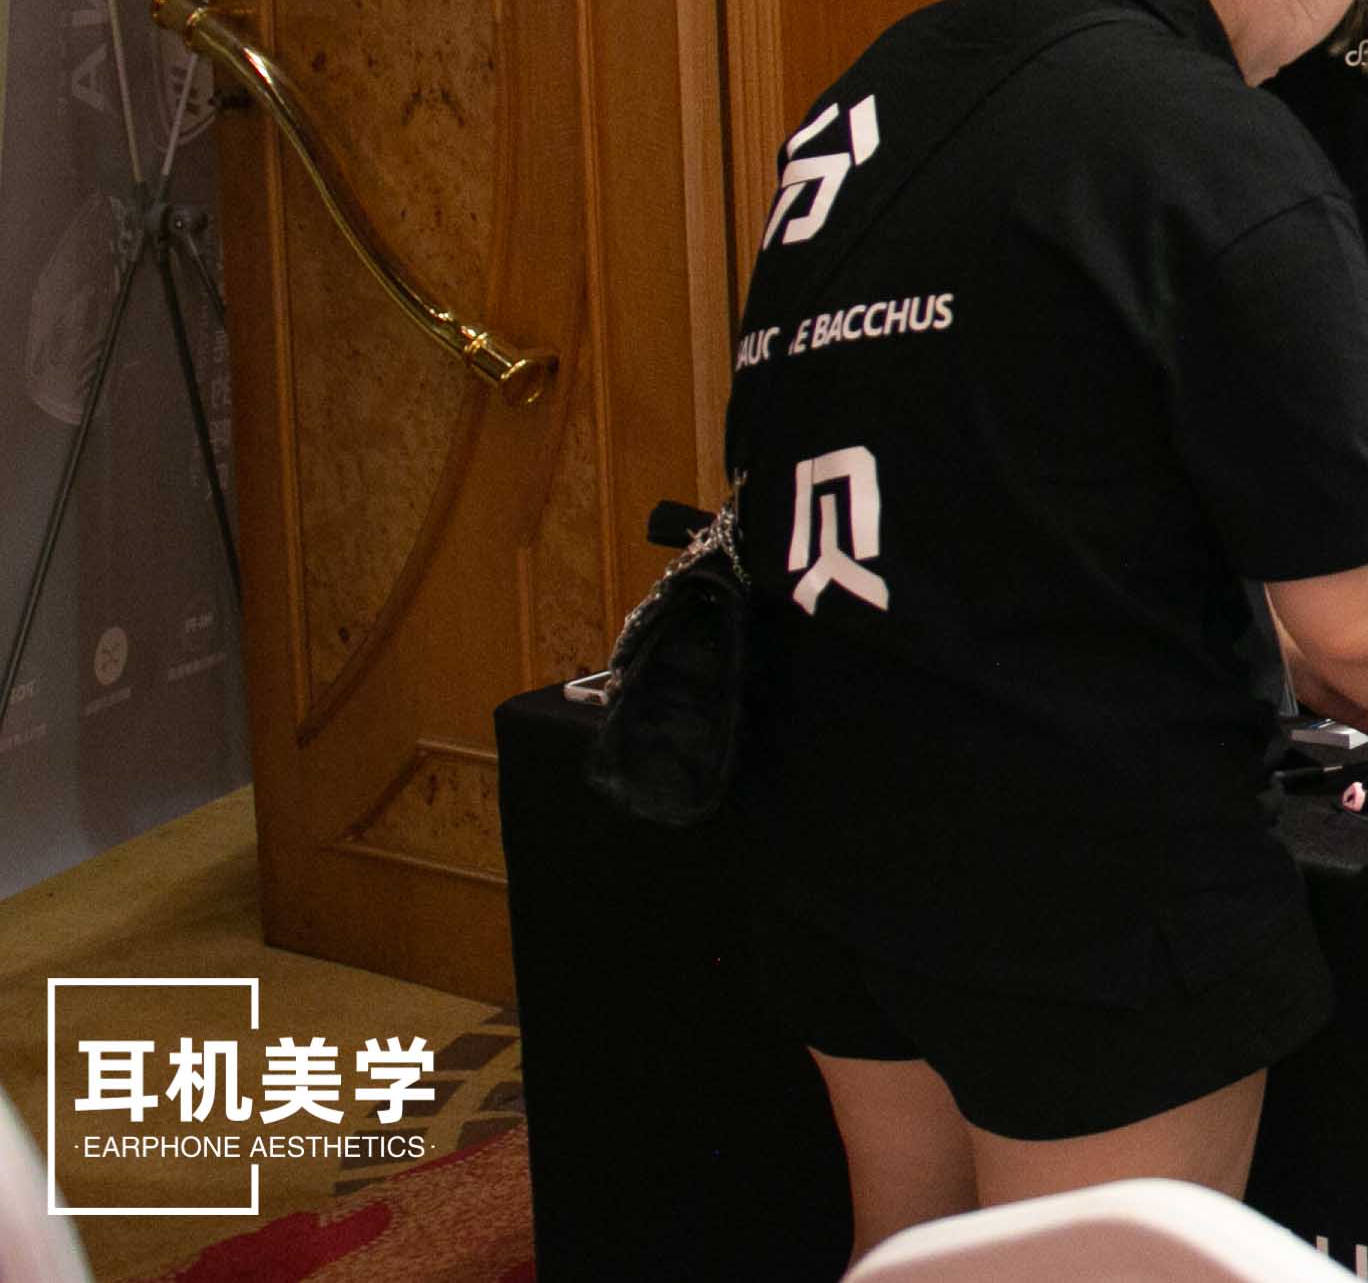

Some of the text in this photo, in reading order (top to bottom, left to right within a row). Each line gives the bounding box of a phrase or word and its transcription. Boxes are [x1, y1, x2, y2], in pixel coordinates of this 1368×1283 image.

[763, 94, 880, 250] 分
[734, 293, 955, 371] AUCE BACCHUS
[788, 446, 889, 615] 贝
